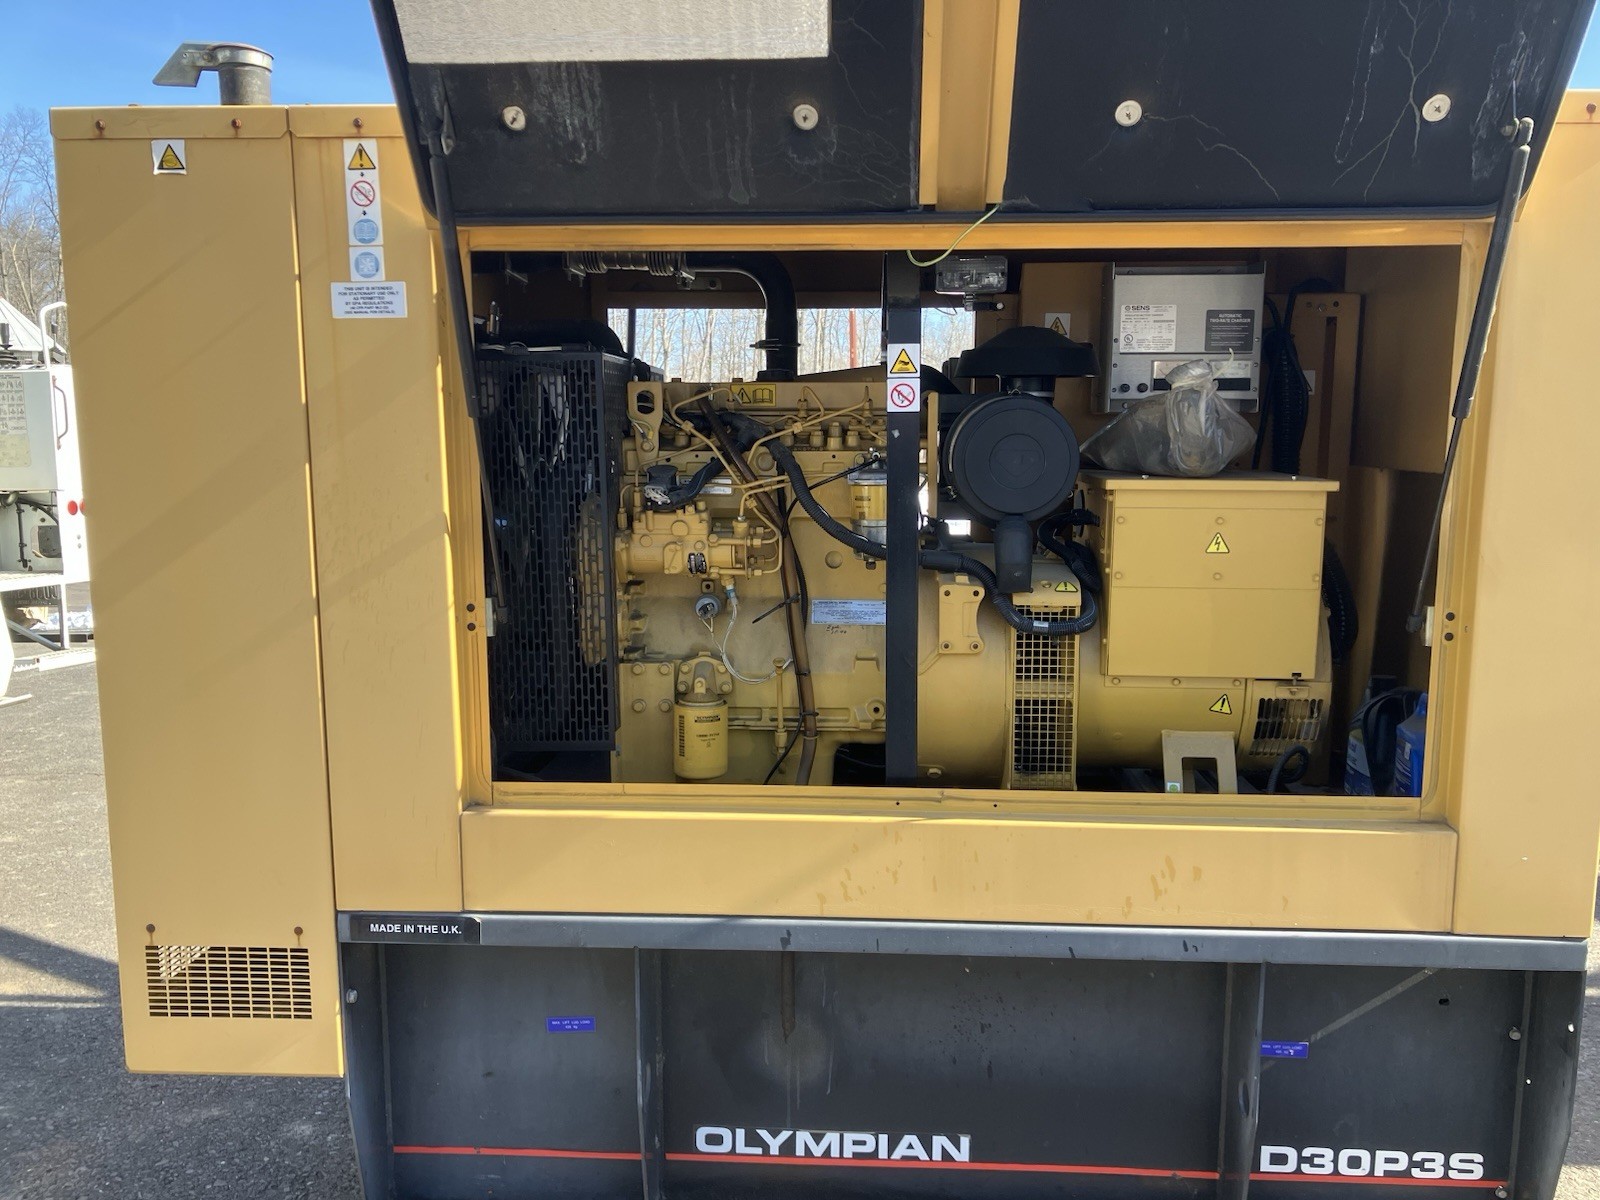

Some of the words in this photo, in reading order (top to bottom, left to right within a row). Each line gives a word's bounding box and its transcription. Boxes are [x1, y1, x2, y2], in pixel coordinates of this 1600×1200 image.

[370, 923, 401, 932] MADE
[404, 924, 415, 933] IN
[417, 924, 438, 933] THE
[441, 925, 462, 934] U.K.
[695, 1126, 970, 1162] OLYMPIAN
[1259, 1145, 1485, 1180] D30P3S
